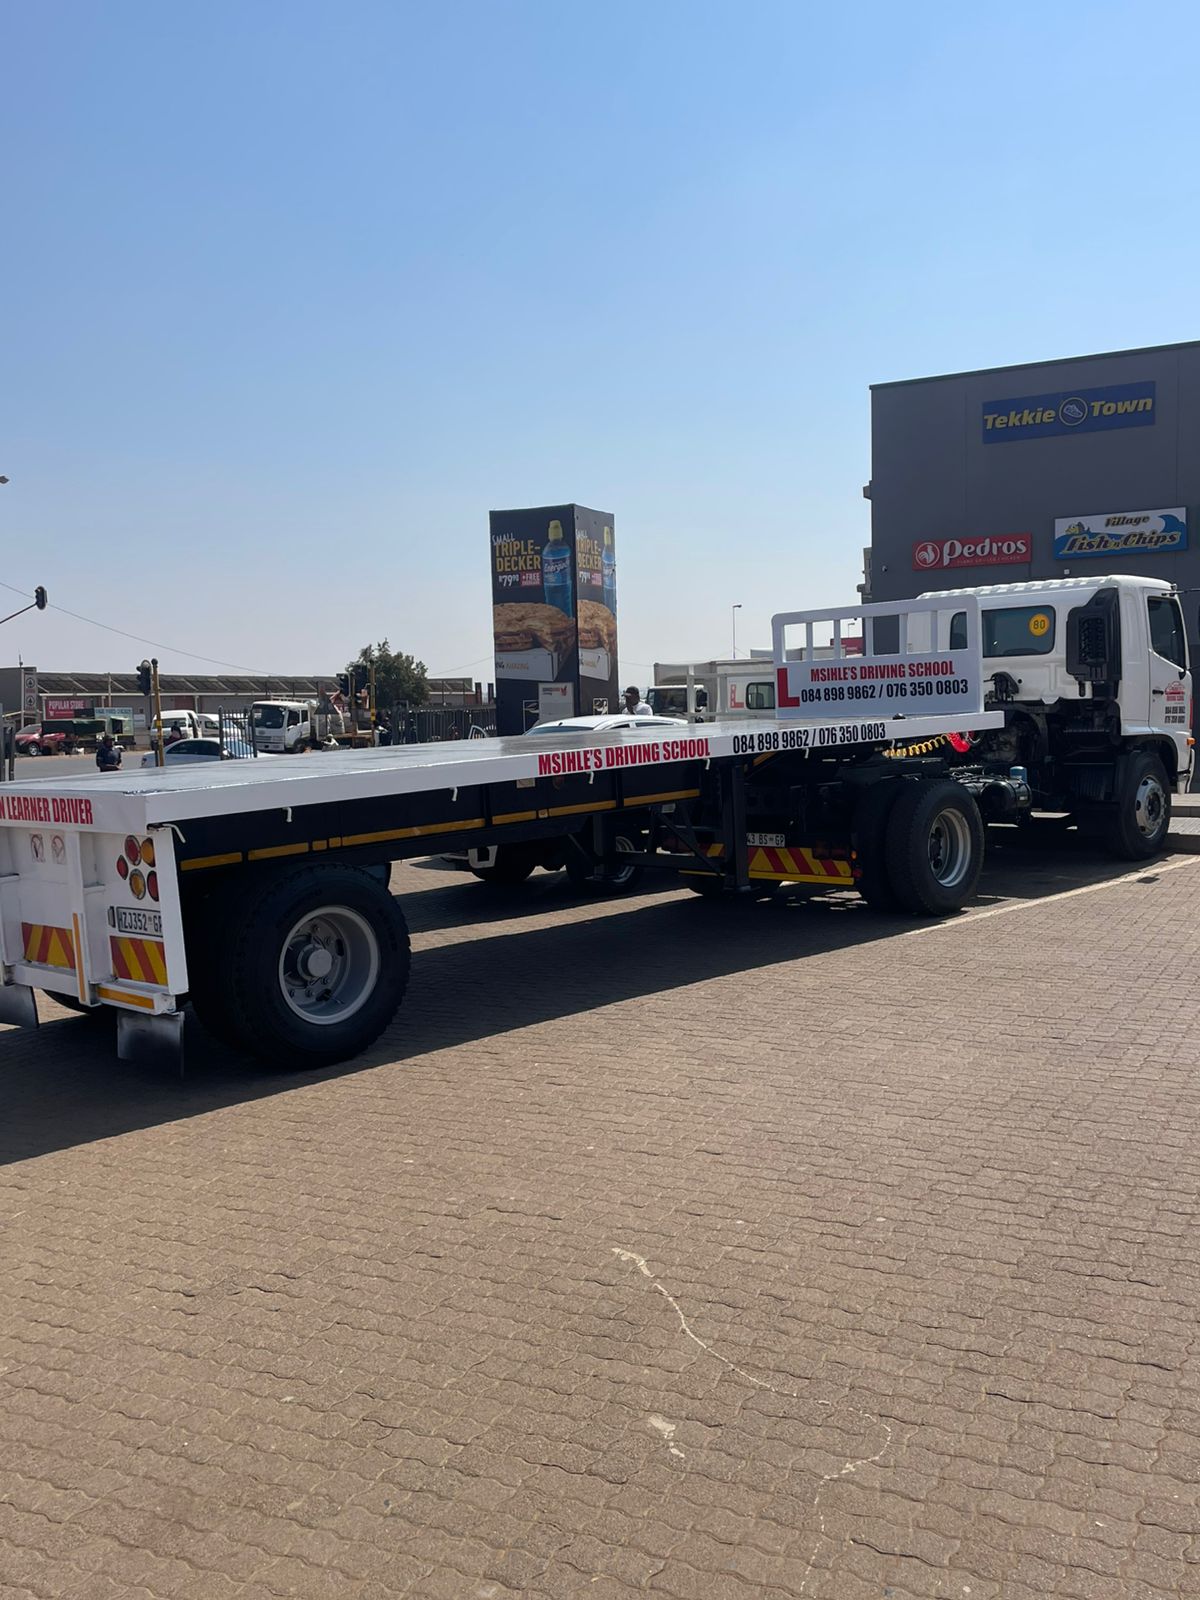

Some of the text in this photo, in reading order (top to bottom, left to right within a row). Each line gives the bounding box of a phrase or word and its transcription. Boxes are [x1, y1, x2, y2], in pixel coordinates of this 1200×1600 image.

[983, 397, 1153, 430] Tekkie Town
[1105, 515, 1150, 527] Village
[495, 539, 541, 557] TRIPLE-
[943, 537, 1027, 566] Pedros
[1064, 535, 1110, 553] Fish
[1122, 530, 1181, 549] Chips
[496, 554, 541, 572] DECKER
[1033, 620, 1046, 630] 80
[811, 660, 955, 682] MSIHLE'S DRIVING SCHOOL
[777, 668, 800, 707] L
[801, 688, 822, 702] 084
[824, 687, 845, 701] 898
[847, 684, 876, 700] 9862
[886, 683, 907, 697] 076
[910, 681, 933, 696] 350
[936, 679, 969, 695] 0803
[733, 734, 755, 754] 084
[758, 732, 779, 751] 898
[782, 729, 809, 749] 9862
[819, 727, 837, 745] 076
[839, 725, 859, 743] 350
[861, 722, 886, 740] 0803
[538, 738, 710, 775] MSIHLE'S DRIVING SCHOOL
[6, 796, 51, 823] LEARNER
[52, 798, 93, 825] DRIVER
